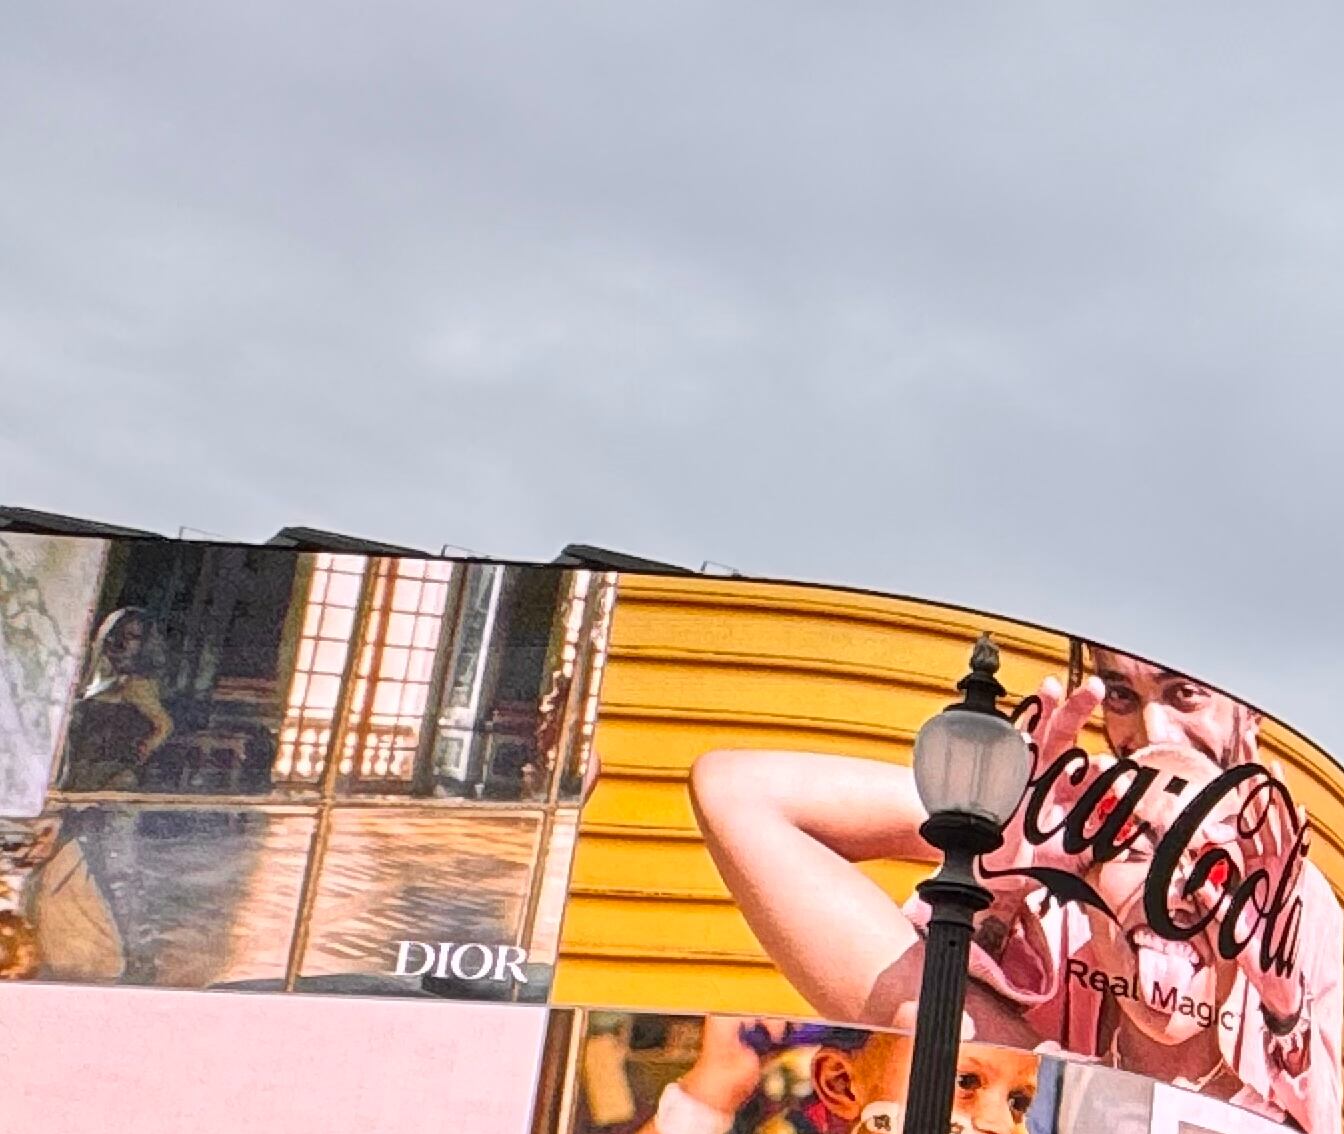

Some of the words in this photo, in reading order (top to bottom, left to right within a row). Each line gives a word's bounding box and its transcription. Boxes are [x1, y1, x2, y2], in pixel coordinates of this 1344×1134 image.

[390, 940, 528, 984] DIOR
[1066, 959, 1138, 1001] Real
[1150, 981, 1234, 1032] Magic
